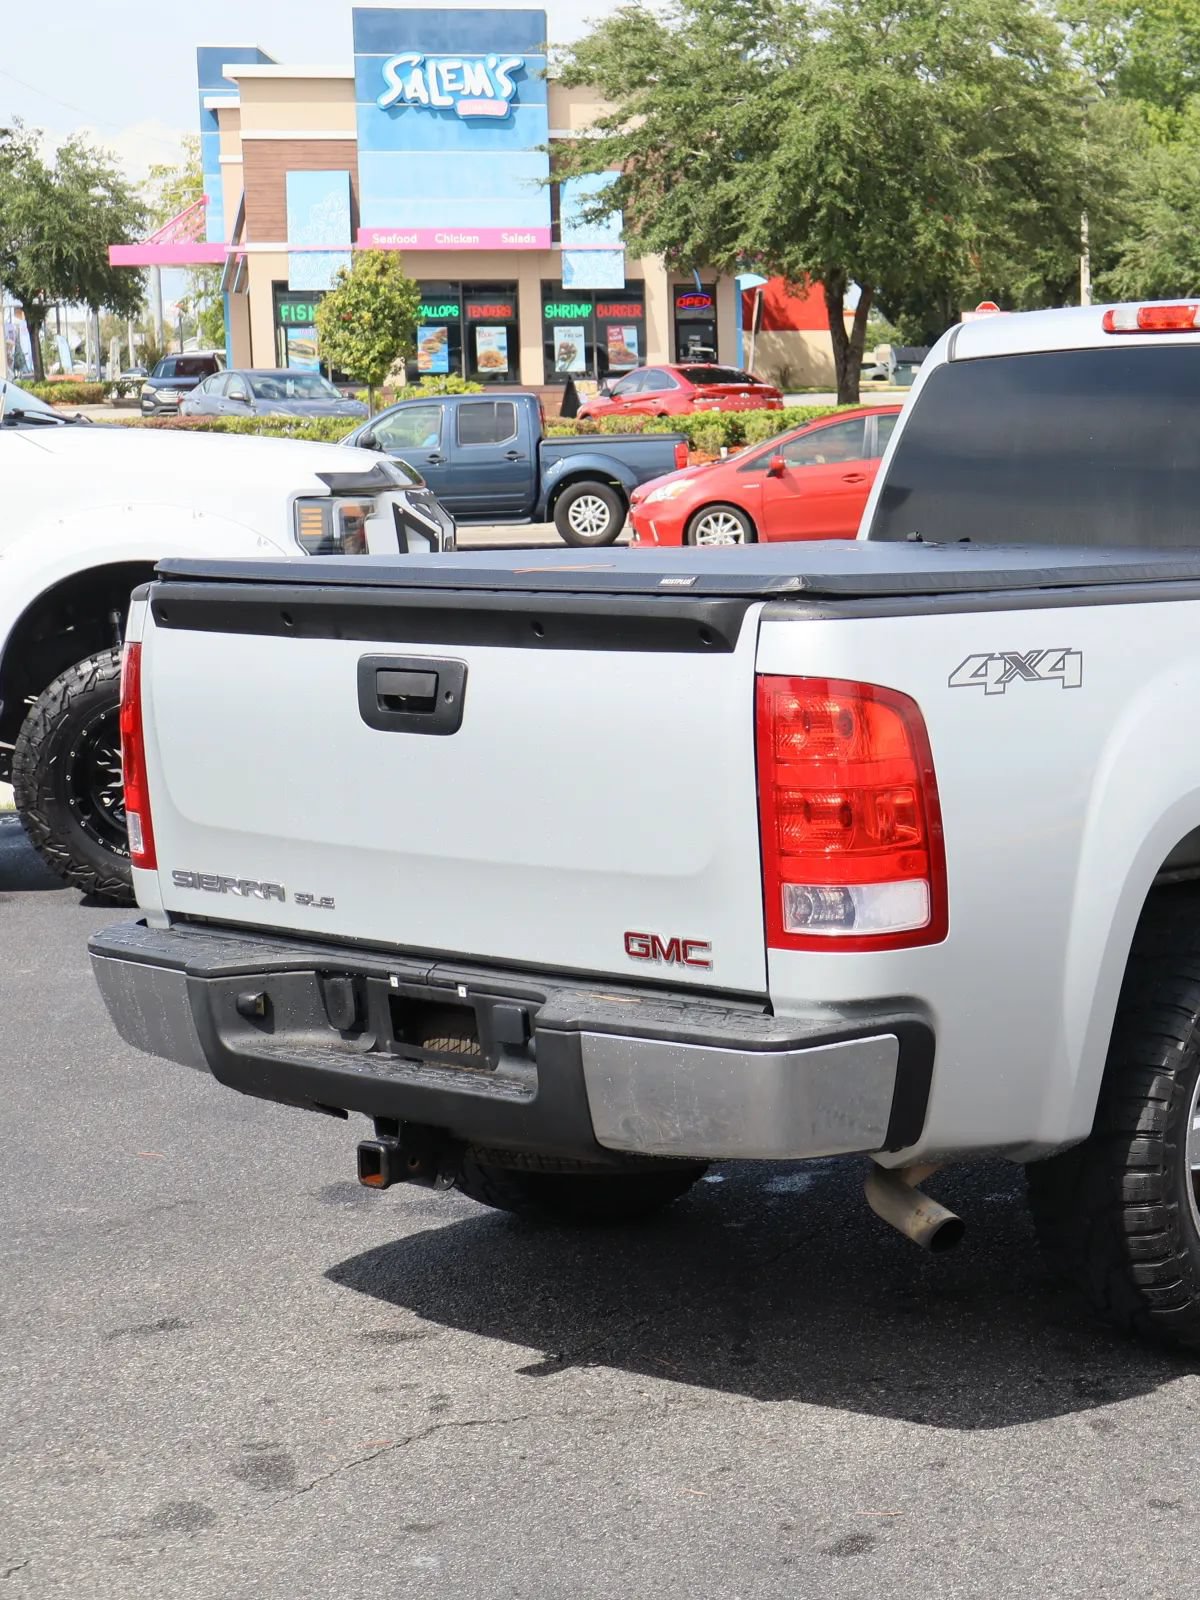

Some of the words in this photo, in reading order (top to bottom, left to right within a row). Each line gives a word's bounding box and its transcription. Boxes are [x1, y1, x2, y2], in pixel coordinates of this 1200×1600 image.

[379, 54, 521, 106] SALEM'S
[372, 233, 418, 244] Seafood
[434, 233, 480, 244] Chicken
[501, 233, 536, 244] Salads
[676, 297, 711, 307] OPEN
[545, 303, 592, 318] SHRIMP
[596, 303, 642, 318] BURGER
[171, 869, 286, 902] SIERRA
[294, 892, 336, 909] SLE
[623, 930, 713, 969] GMC
